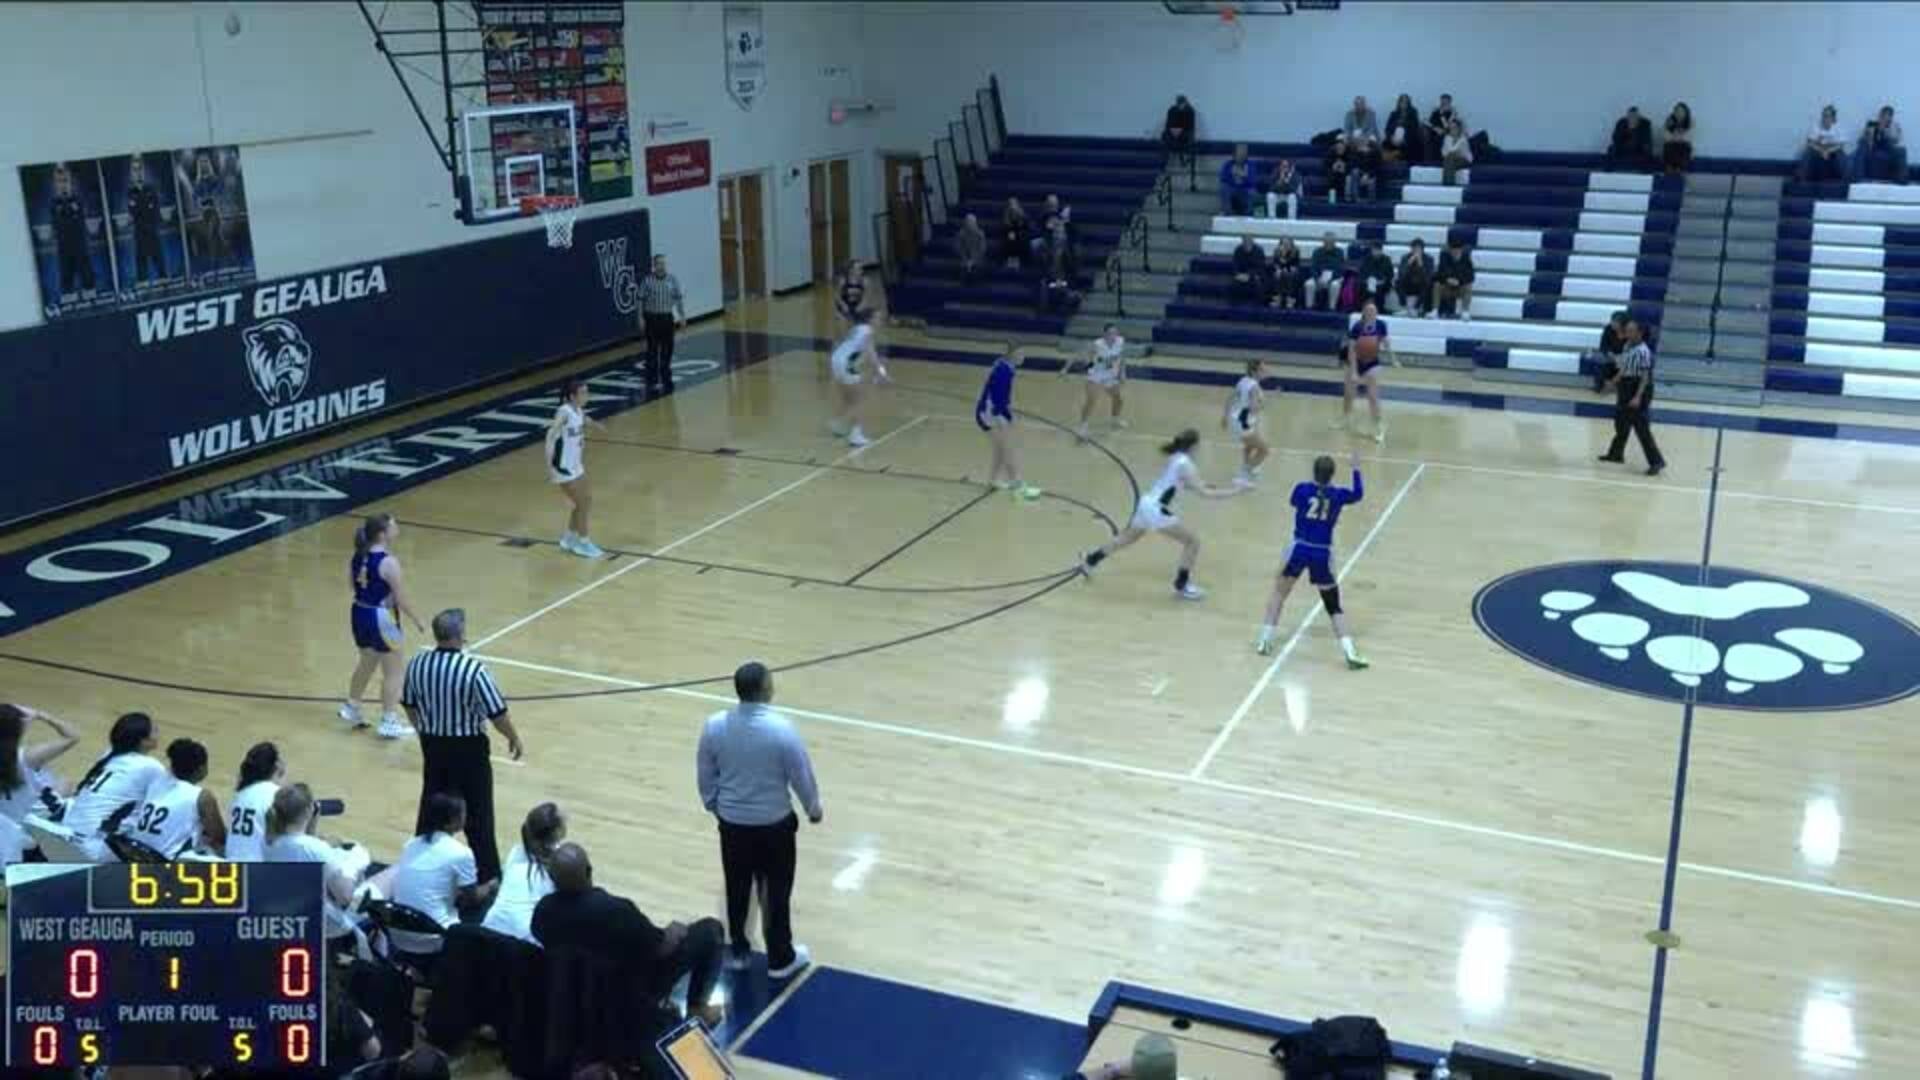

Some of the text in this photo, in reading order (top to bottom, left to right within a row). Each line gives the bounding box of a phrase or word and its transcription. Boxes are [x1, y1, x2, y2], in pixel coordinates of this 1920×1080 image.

[136, 294, 243, 345] WEST
[253, 265, 388, 320] GEAUGA
[168, 379, 387, 469] WOLVERINES
[1305, 497, 1330, 520] 21
[137, 802, 170, 835] 32
[230, 806, 256, 836] 25
